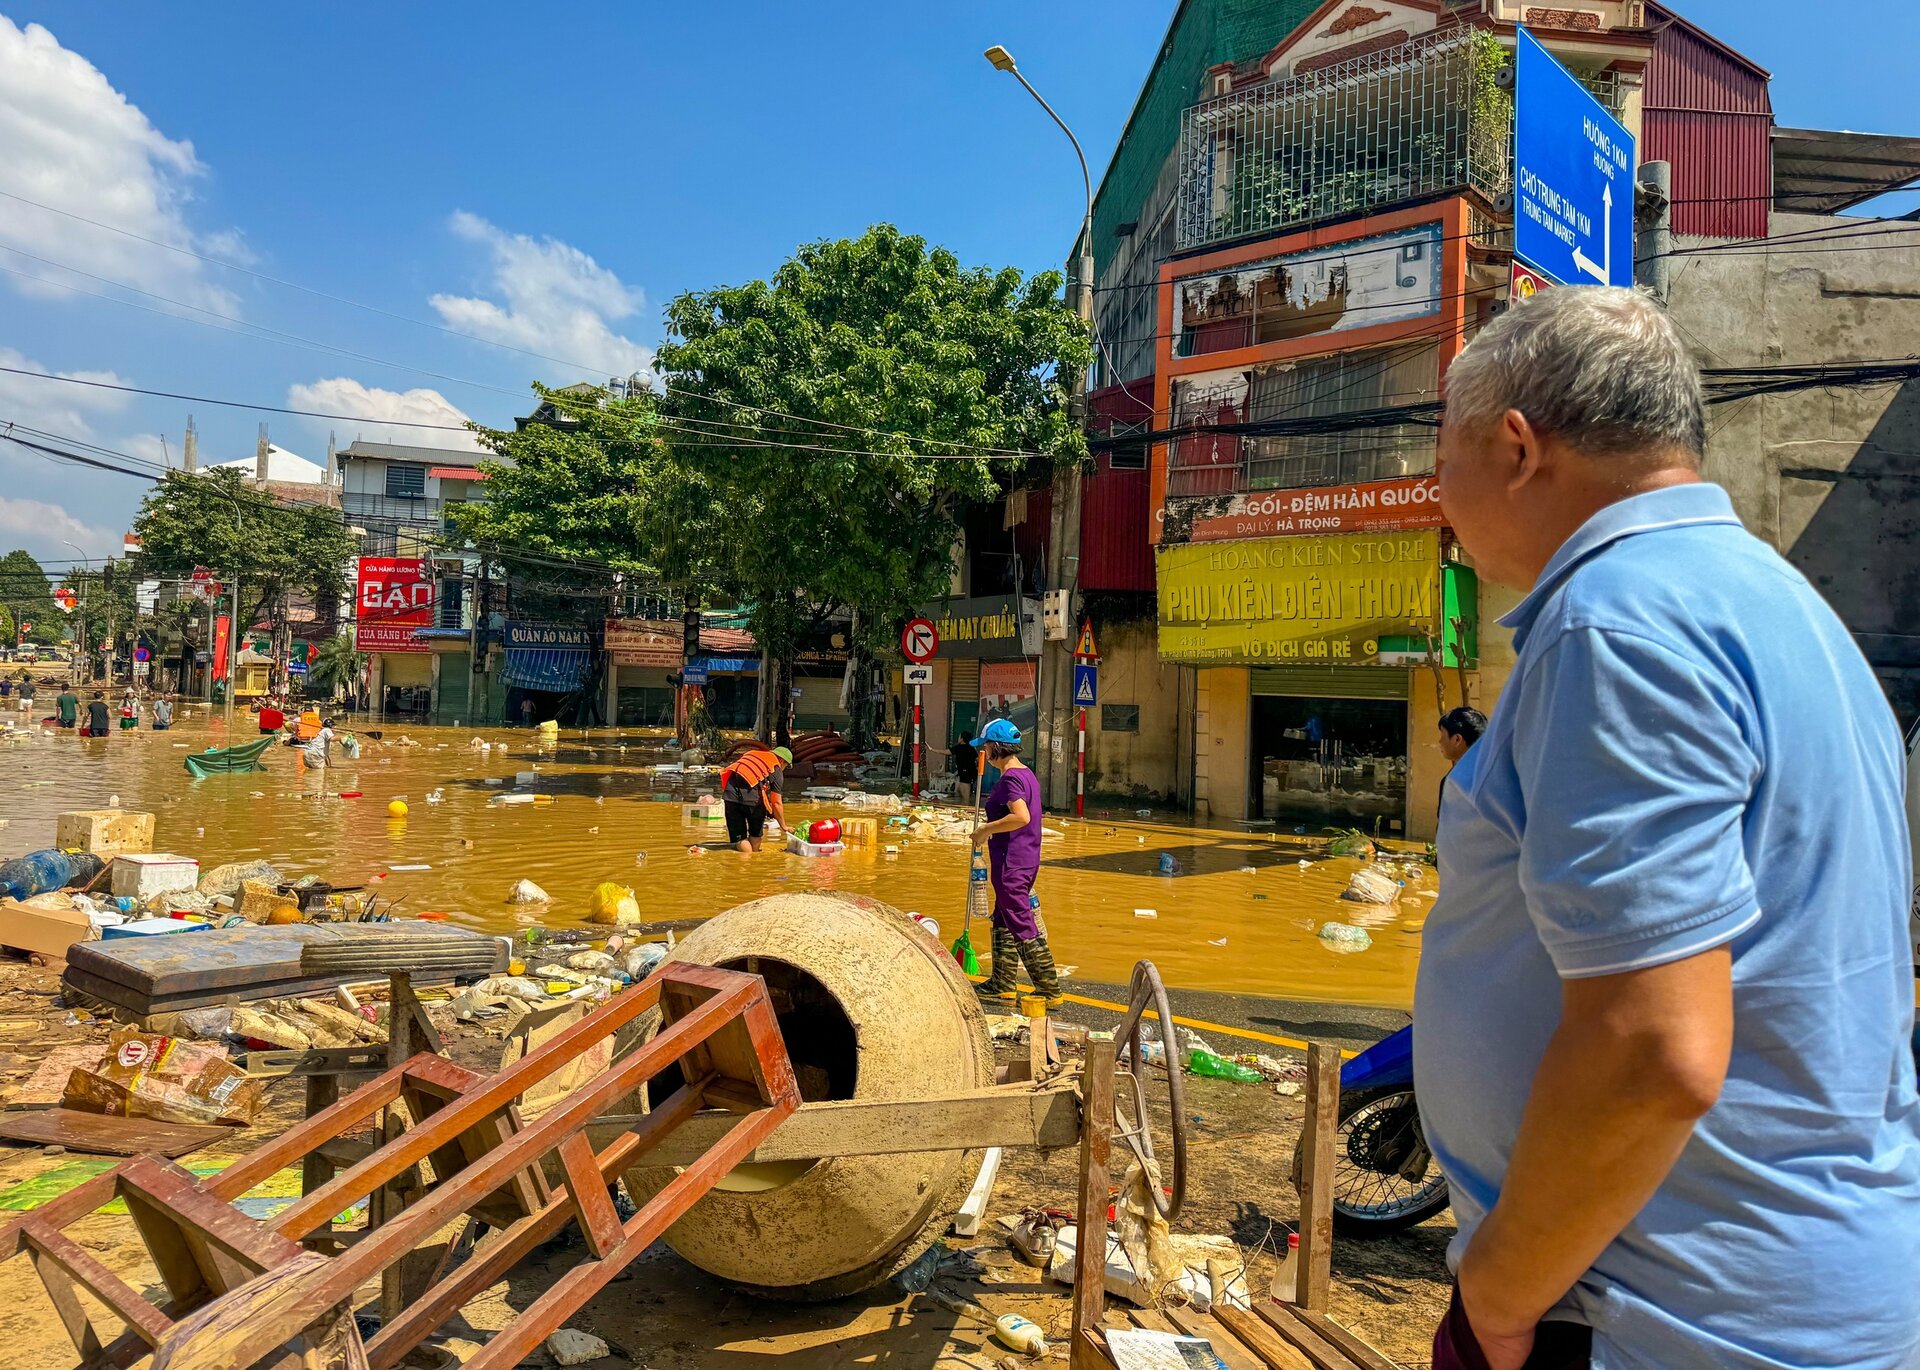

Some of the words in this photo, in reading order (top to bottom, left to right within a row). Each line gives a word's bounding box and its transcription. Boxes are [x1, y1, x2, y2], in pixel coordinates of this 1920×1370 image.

[1593, 150, 1615, 181] HUONG
[1612, 143, 1627, 172] 1KM
[1520, 166, 1537, 199] CHỢ
[1537, 178, 1561, 216] TRUNG
[1562, 198, 1576, 227] TÂM
[1577, 211, 1591, 238] 1KM
[1522, 195, 1542, 224] TRUNG
[1542, 209, 1554, 233] TAM
[1554, 219, 1576, 249] MARKET
[1333, 487, 1376, 510] HÀN
[1276, 516, 1294, 531] HÀ
[1298, 516, 1341, 531] TRỌNG
[1208, 544, 1285, 571] HOÀNG
[1292, 540, 1343, 567] KIÊN
[1351, 540, 1425, 564] STORE
[362, 580, 433, 615] GẠO
[1167, 584, 1212, 630] PHỤ
[1219, 575, 1274, 630] KIỆN
[1281, 572, 1343, 629] ĐIỆN
[1349, 576, 1433, 628] THOẠI
[511, 626, 541, 643] QUẦN
[542, 628, 556, 643] ÁO
[558, 631, 581, 644] NAM
[980, 603, 1016, 640] CHUẨN
[1241, 638, 1262, 658] VÔ
[1267, 640, 1299, 661] ĐỊCH
[1303, 636, 1329, 658] GIÁ
[1332, 635, 1352, 658] RẺ
